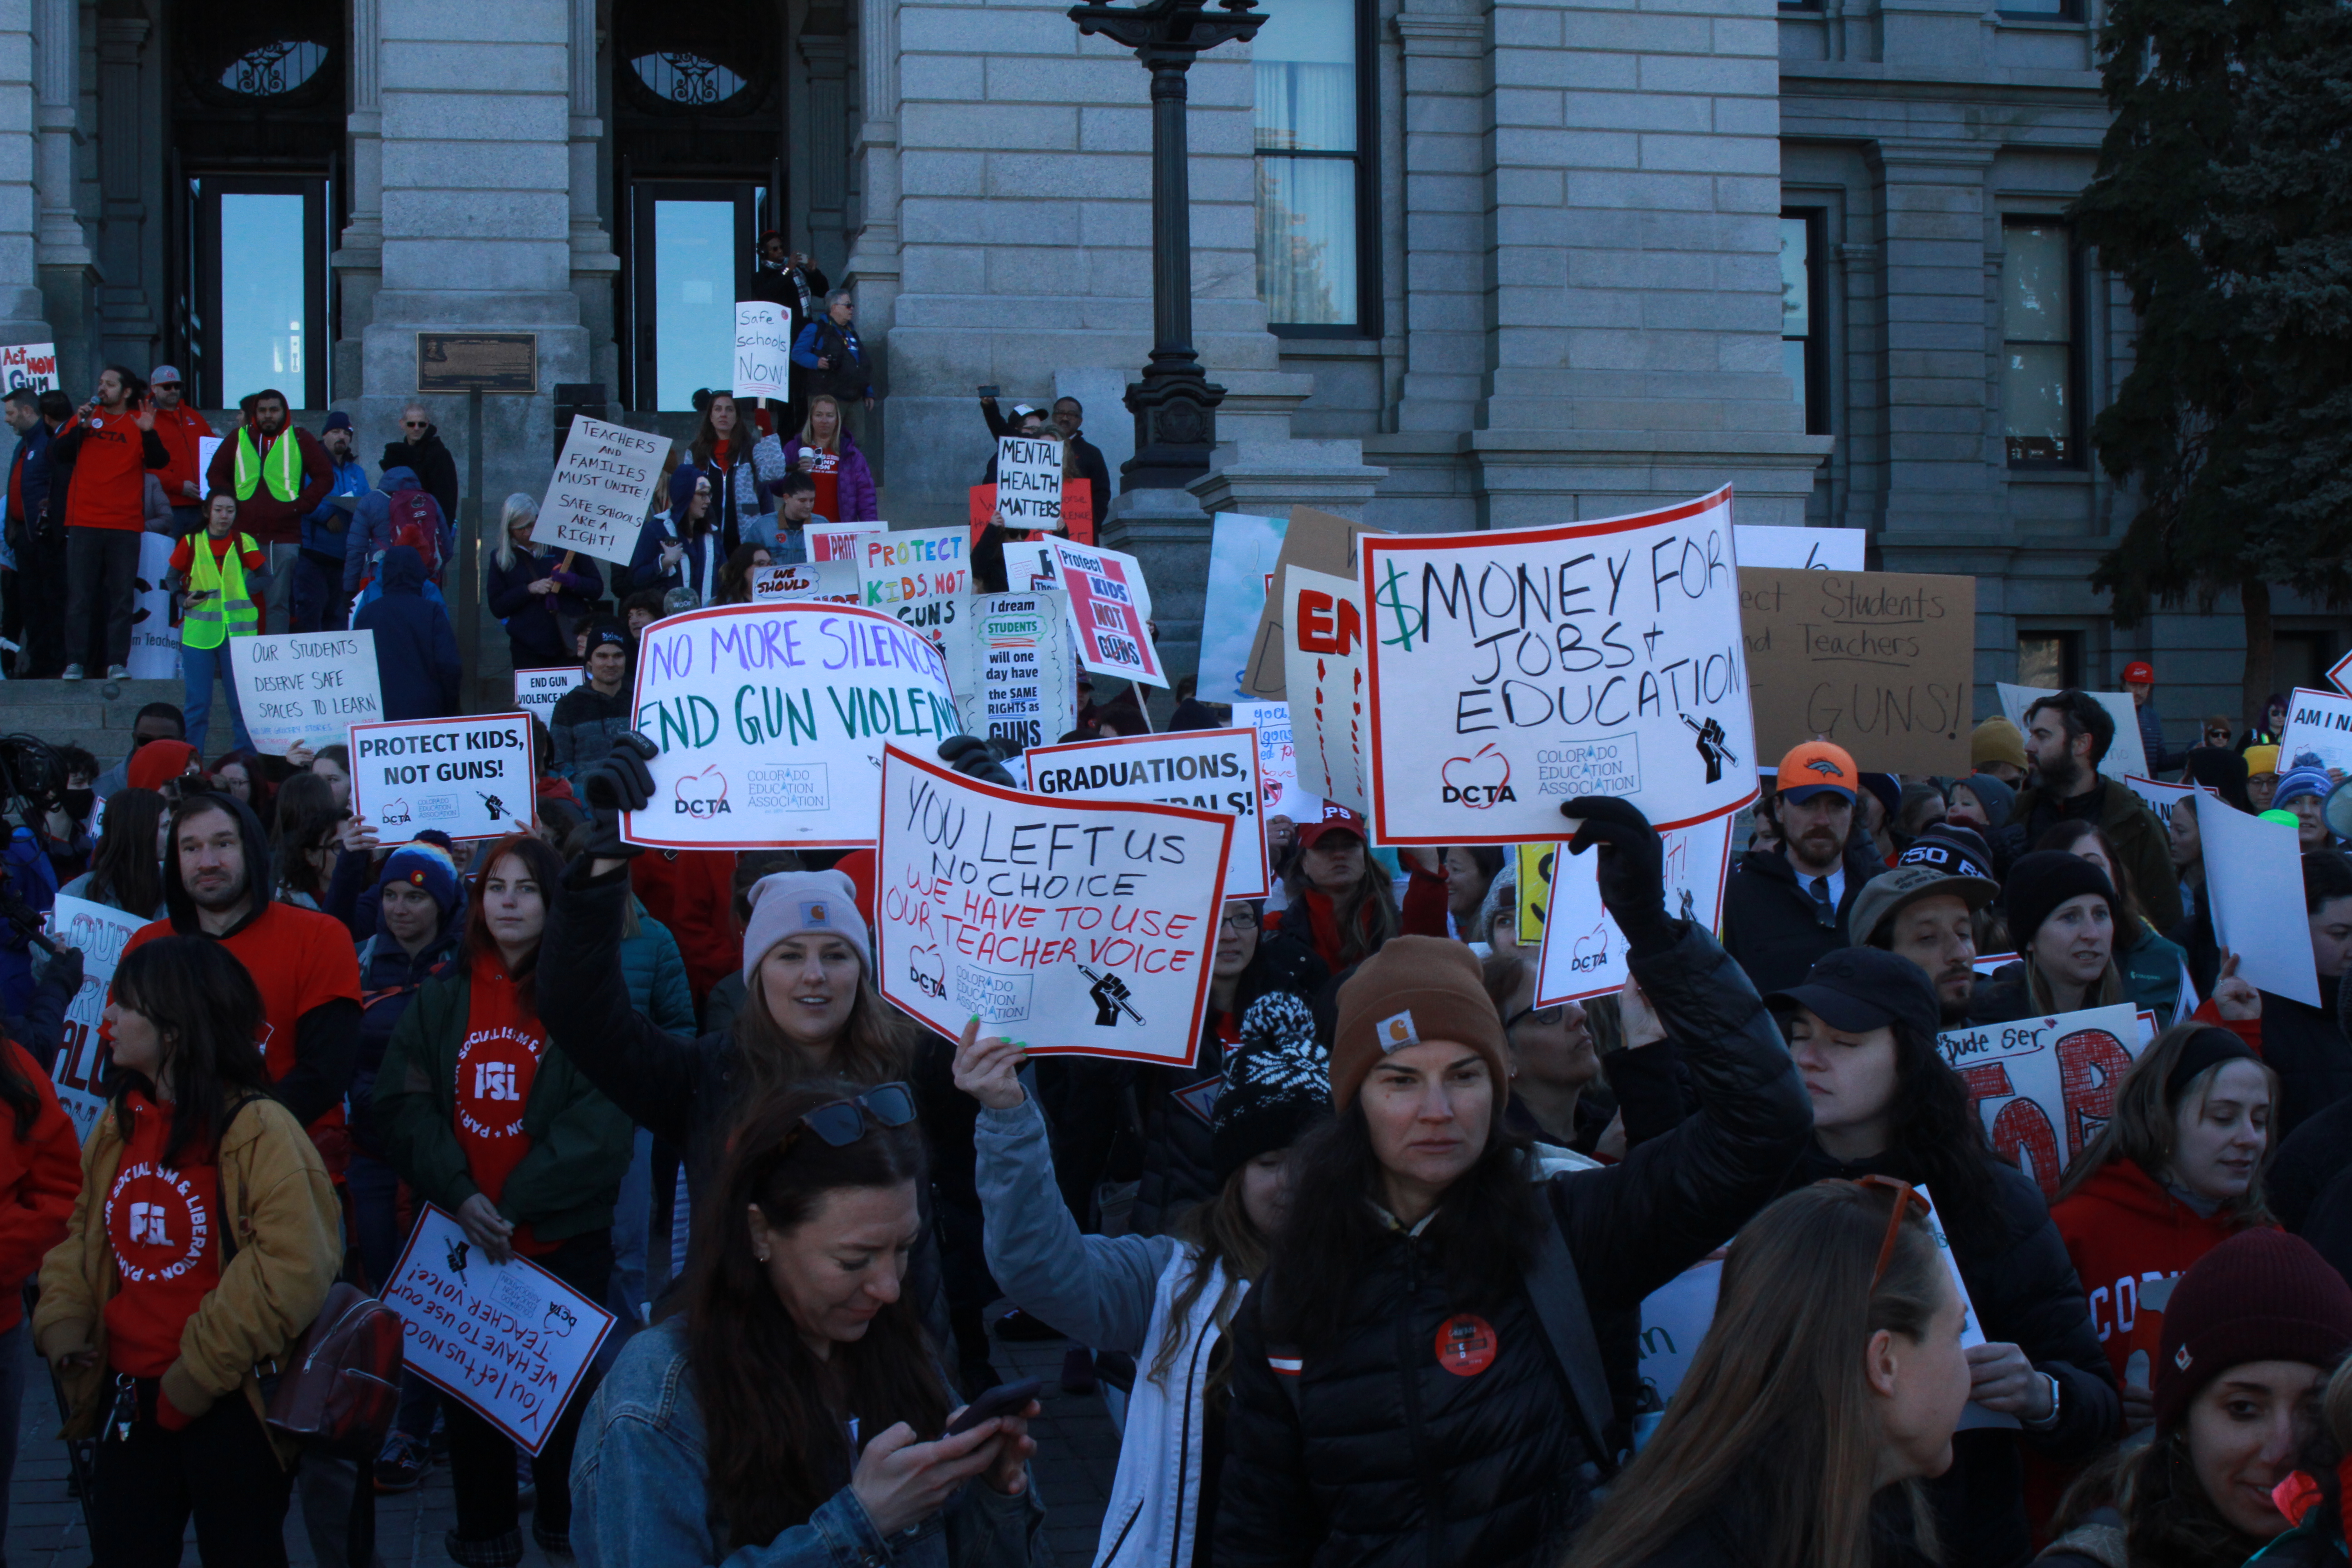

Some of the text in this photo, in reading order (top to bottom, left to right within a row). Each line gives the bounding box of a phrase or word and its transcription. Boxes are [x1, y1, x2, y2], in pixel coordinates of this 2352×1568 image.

[740, 310, 774, 325] Safe
[737, 331, 786, 352] schools
[3, 347, 26, 366] Act
[26, 356, 56, 375] NOW
[583, 421, 656, 453] TEACHERS
[599, 446, 622, 456] AND
[1002, 440, 1061, 467] MENTAL
[570, 454, 647, 482] FAMILIES
[558, 471, 650, 500] MUST UNITE!
[1001, 470, 1059, 493] HEALTH
[559, 495, 643, 527] SAFE SCHOOLS
[999, 497, 1060, 518] MATTERS
[571, 514, 607, 531] ARE A
[558, 525, 614, 552] RIGHT!
[868, 537, 962, 568] PROTECT
[1060, 550, 1103, 573] Protect
[757, 579, 810, 593] SHOULD
[773, 568, 796, 579] WE
[867, 570, 965, 606] KIDS, NOT
[1091, 577, 1127, 602] KIDS
[1376, 530, 1729, 652] $MONEY FOR
[1822, 577, 1945, 618] Students
[897, 601, 955, 627] GUNS
[991, 600, 1035, 612] I dream
[1092, 603, 1124, 630] NOT
[988, 621, 1037, 633] STUDENTS
[253, 640, 358, 663] OUR STUDENTS
[652, 617, 944, 686] NO MORE SILENCE
[1098, 636, 1140, 665] GUNS
[1473, 622, 1635, 685] JOBS
[1743, 624, 1920, 657] nd Teachers
[990, 652, 1034, 663] will one
[255, 670, 343, 692] DESERVE SAFE
[531, 676, 568, 688] END GUN
[986, 667, 1038, 681] day have
[1457, 637, 1740, 734] EDUCATION
[260, 693, 377, 719] SPACES TO LEARN
[518, 693, 558, 704] VIOLENCE
[989, 686, 1037, 700] the SAME
[637, 694, 719, 754] END
[735, 685, 817, 745] GUN
[988, 702, 1039, 715] RIGHTS as
[1808, 682, 1962, 740] GUNS!
[2294, 708, 2322, 726] AM
[2325, 712, 2332, 728] I
[360, 733, 460, 758] PROTECT
[466, 730, 524, 750] KIDS,
[989, 720, 1041, 747] GUNS
[1537, 745, 1617, 764] COLORADO
[384, 760, 504, 785] NOT GUNS!
[748, 768, 810, 782] COLORADO
[1039, 753, 1248, 794] GRADUATIONS,
[1539, 761, 1623, 780] EDUCATION
[749, 781, 813, 795] EDUCATION
[1442, 785, 1517, 803] DCTA
[1538, 776, 1634, 796] ASSOCIATION
[419, 810, 457, 818] ASSOCIATION
[675, 799, 731, 813] DCTA
[748, 794, 823, 808] ASSOCIATION
[1324, 806, 1352, 820] PS
[382, 815, 412, 824] DCTA
[907, 776, 1186, 870] YOU LEFT US
[932, 852, 1147, 898] NO CHOICE
[908, 863, 1198, 939] WE HAVE TO USE
[886, 885, 1195, 974] OUR TEACHER VOICE
[1571, 952, 1607, 971] DCTA
[910, 966, 947, 1000] DCTA
[956, 965, 1013, 992] COLORADO
[956, 979, 1016, 1006] EDUCATION
[956, 993, 1024, 1021] ASSOCIATION
[458, 1026, 530, 1060] SOCIALISM
[528, 1039, 539, 1052] &
[475, 1062, 520, 1101] PSL
[176, 1180, 191, 1196] &
[160, 1195, 208, 1282] LIBERATION
[500, 1275, 542, 1304] ASSOCIATION
[549, 1301, 578, 1327] DCTA
[419, 1331, 451, 1353] NO
[458, 1321, 480, 1345] TO
[467, 1296, 549, 1363] TEACHER
[482, 1336, 530, 1374] HAVE
[529, 1364, 558, 1393] WE
[510, 1379, 544, 1432] You
